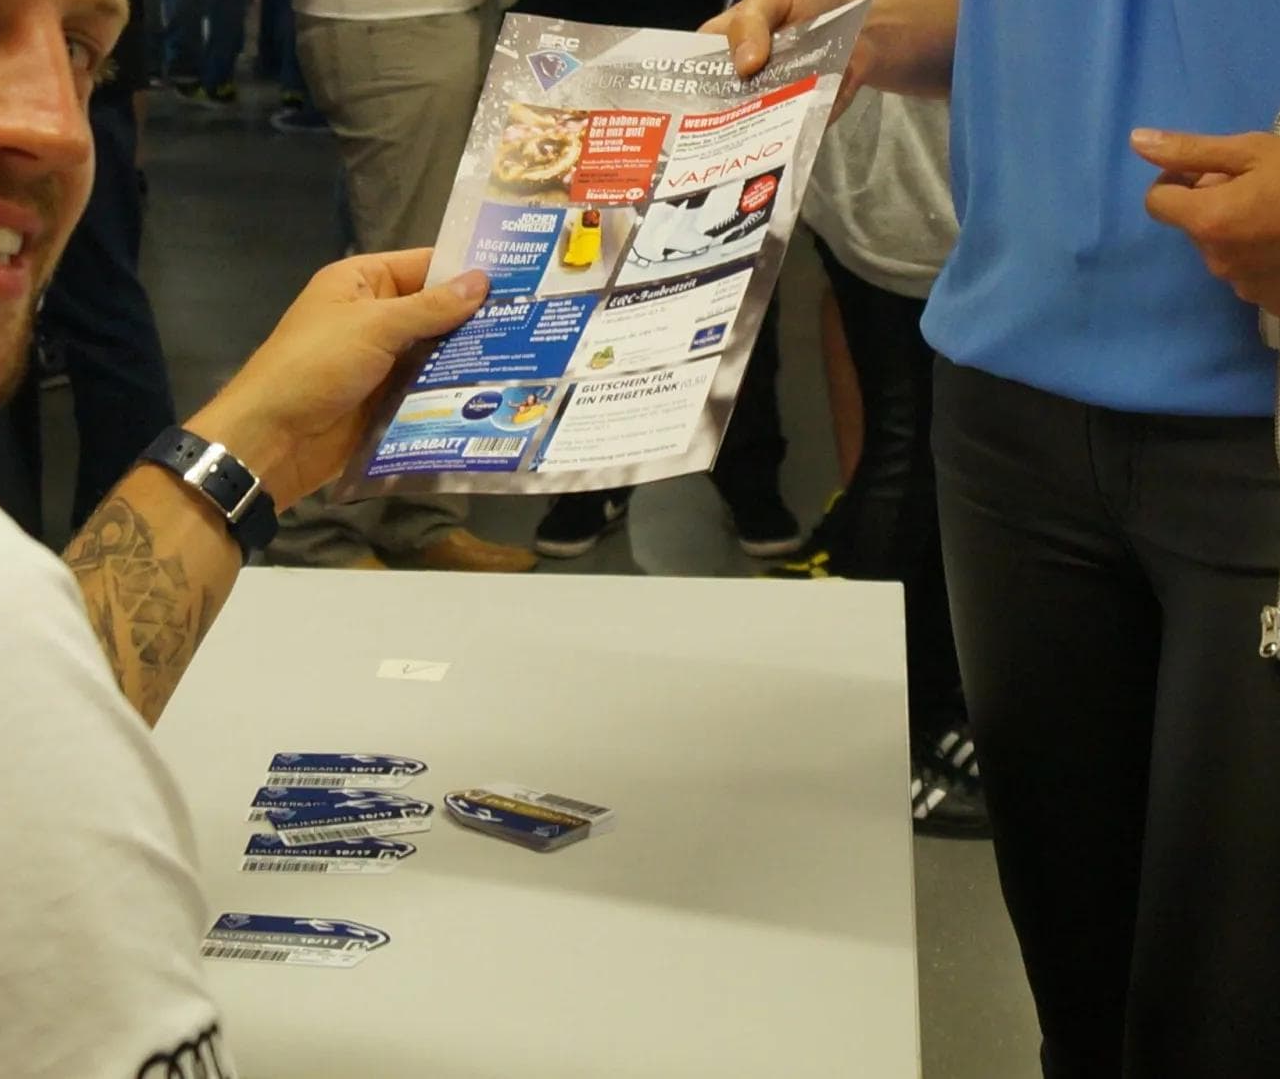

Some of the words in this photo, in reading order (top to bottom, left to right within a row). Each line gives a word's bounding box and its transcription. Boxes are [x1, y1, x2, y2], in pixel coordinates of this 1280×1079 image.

[641, 57, 737, 75] GUTSCHE
[592, 116, 608, 127] Sie
[608, 115, 639, 126] haben
[684, 98, 764, 129] WERTGUTSCHEIN
[668, 141, 783, 188] VAPIANO
[521, 212, 558, 223] JOCHEN
[501, 220, 555, 233] SCHWEIZER
[476, 237, 549, 253] ABGEFAHRENE
[488, 303, 530, 318] Rabatt
[582, 375, 649, 393] GUTSCHEIN
[651, 370, 674, 384] FÜR
[575, 396, 596, 406] EIN
[599, 382, 680, 403] FREIGETRÄNK
[410, 437, 466, 451] RABATT
